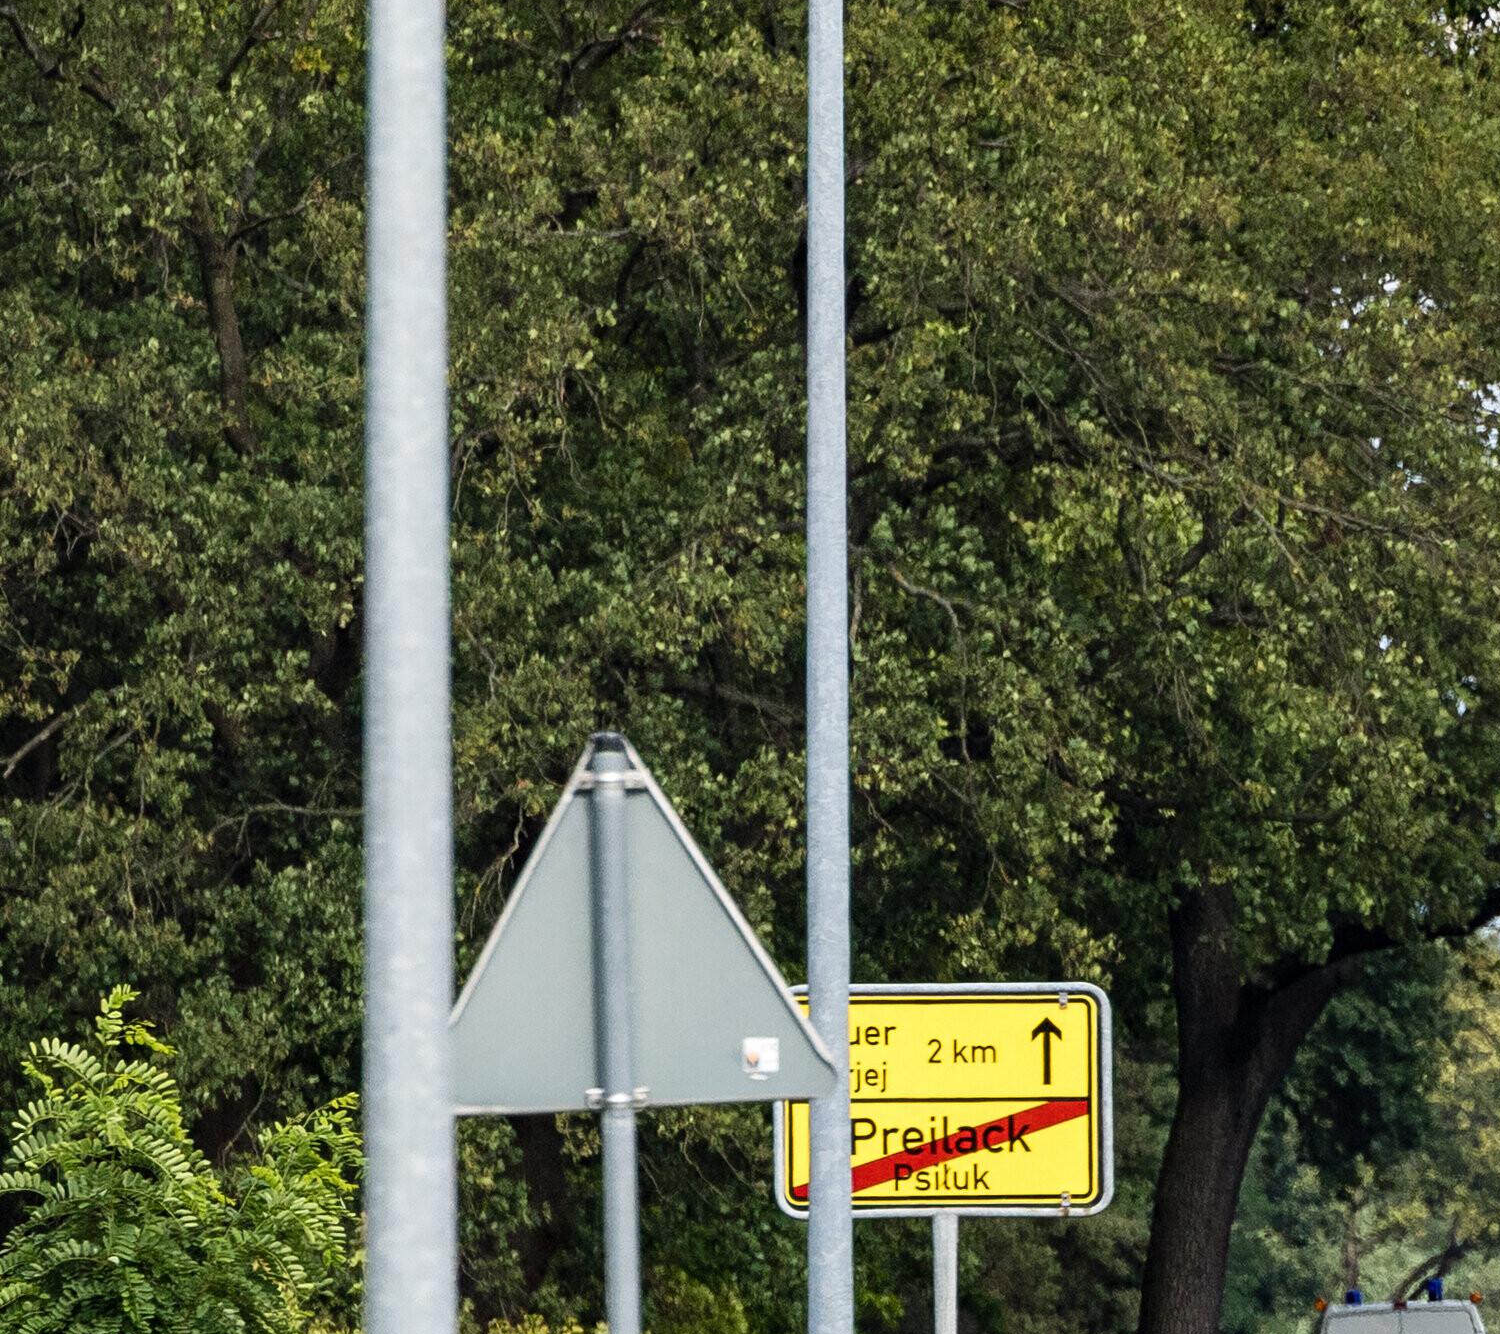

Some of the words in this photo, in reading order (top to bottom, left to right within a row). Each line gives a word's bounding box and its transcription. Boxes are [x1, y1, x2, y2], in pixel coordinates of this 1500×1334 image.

[850, 1026, 896, 1045] uer
[928, 1039, 942, 1063] 2
[953, 1039, 996, 1063] km
[850, 1062, 887, 1093] jej
[850, 1115, 1031, 1155] Preilack
